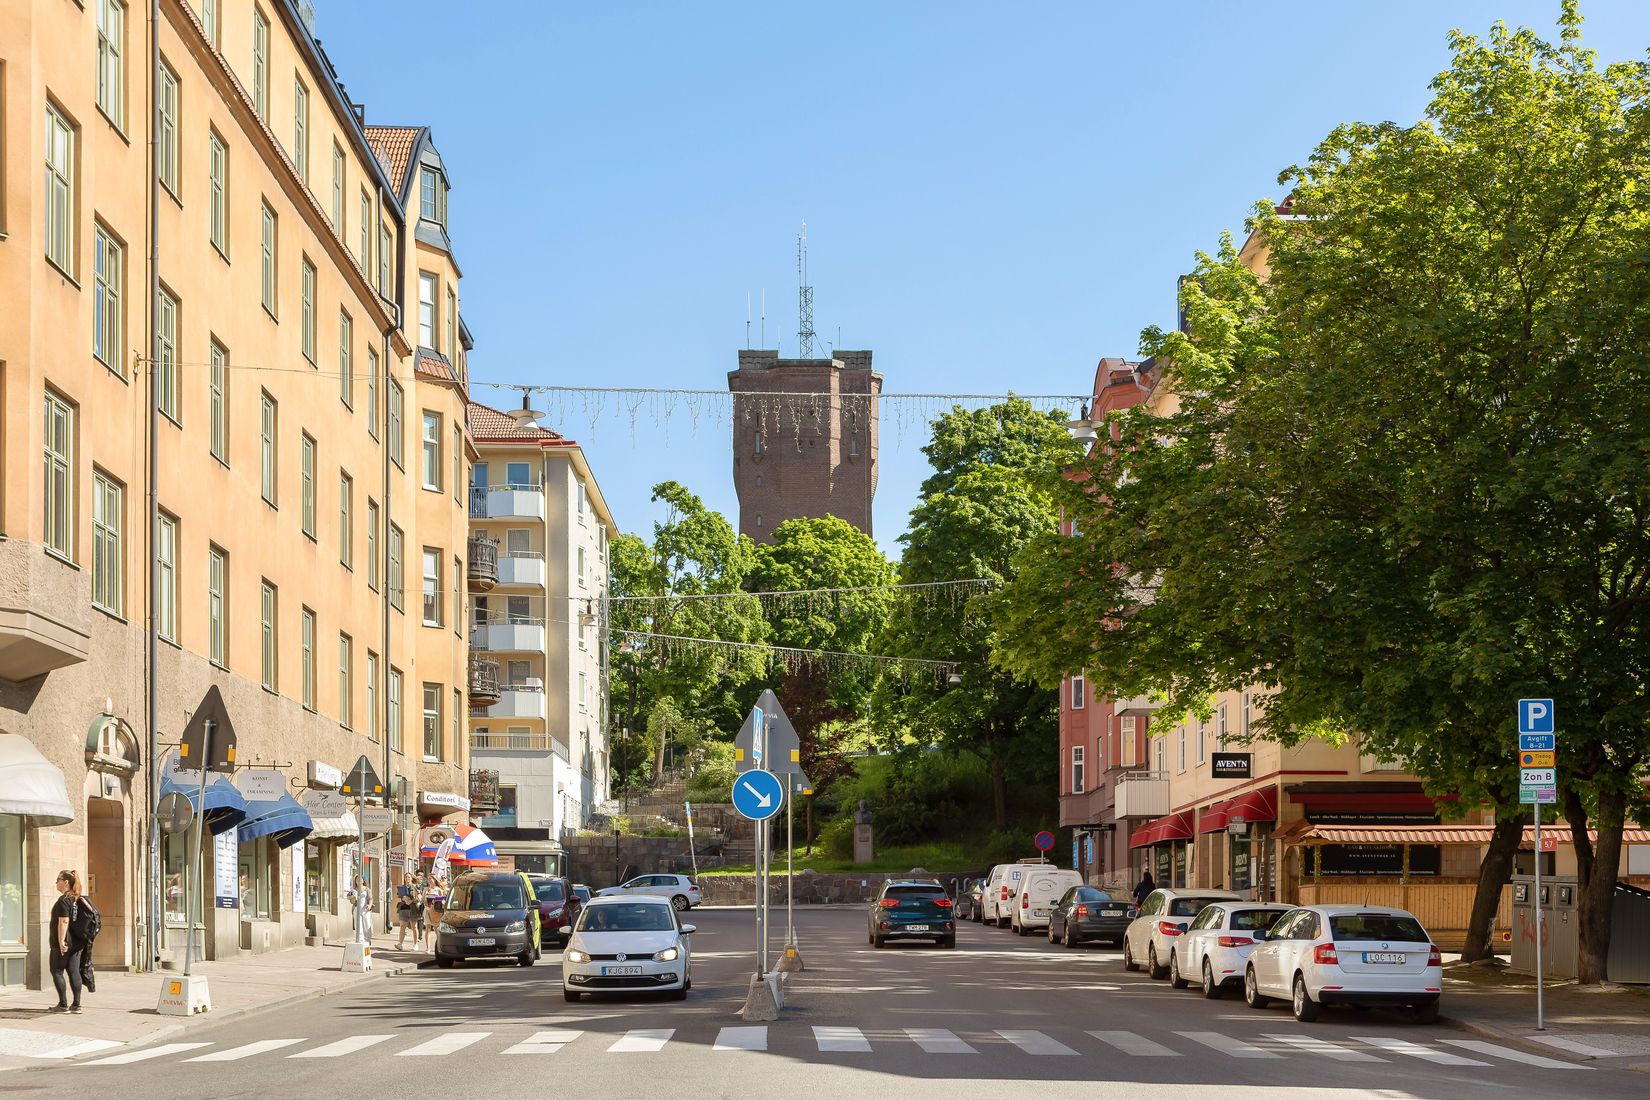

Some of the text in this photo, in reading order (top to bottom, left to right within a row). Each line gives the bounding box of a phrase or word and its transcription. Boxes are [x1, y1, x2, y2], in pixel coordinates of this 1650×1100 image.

[1528, 703, 1547, 729] P
[426, 794, 455, 803] Conditori
[322, 800, 345, 809] Center
[1369, 953, 1385, 961] LOC
